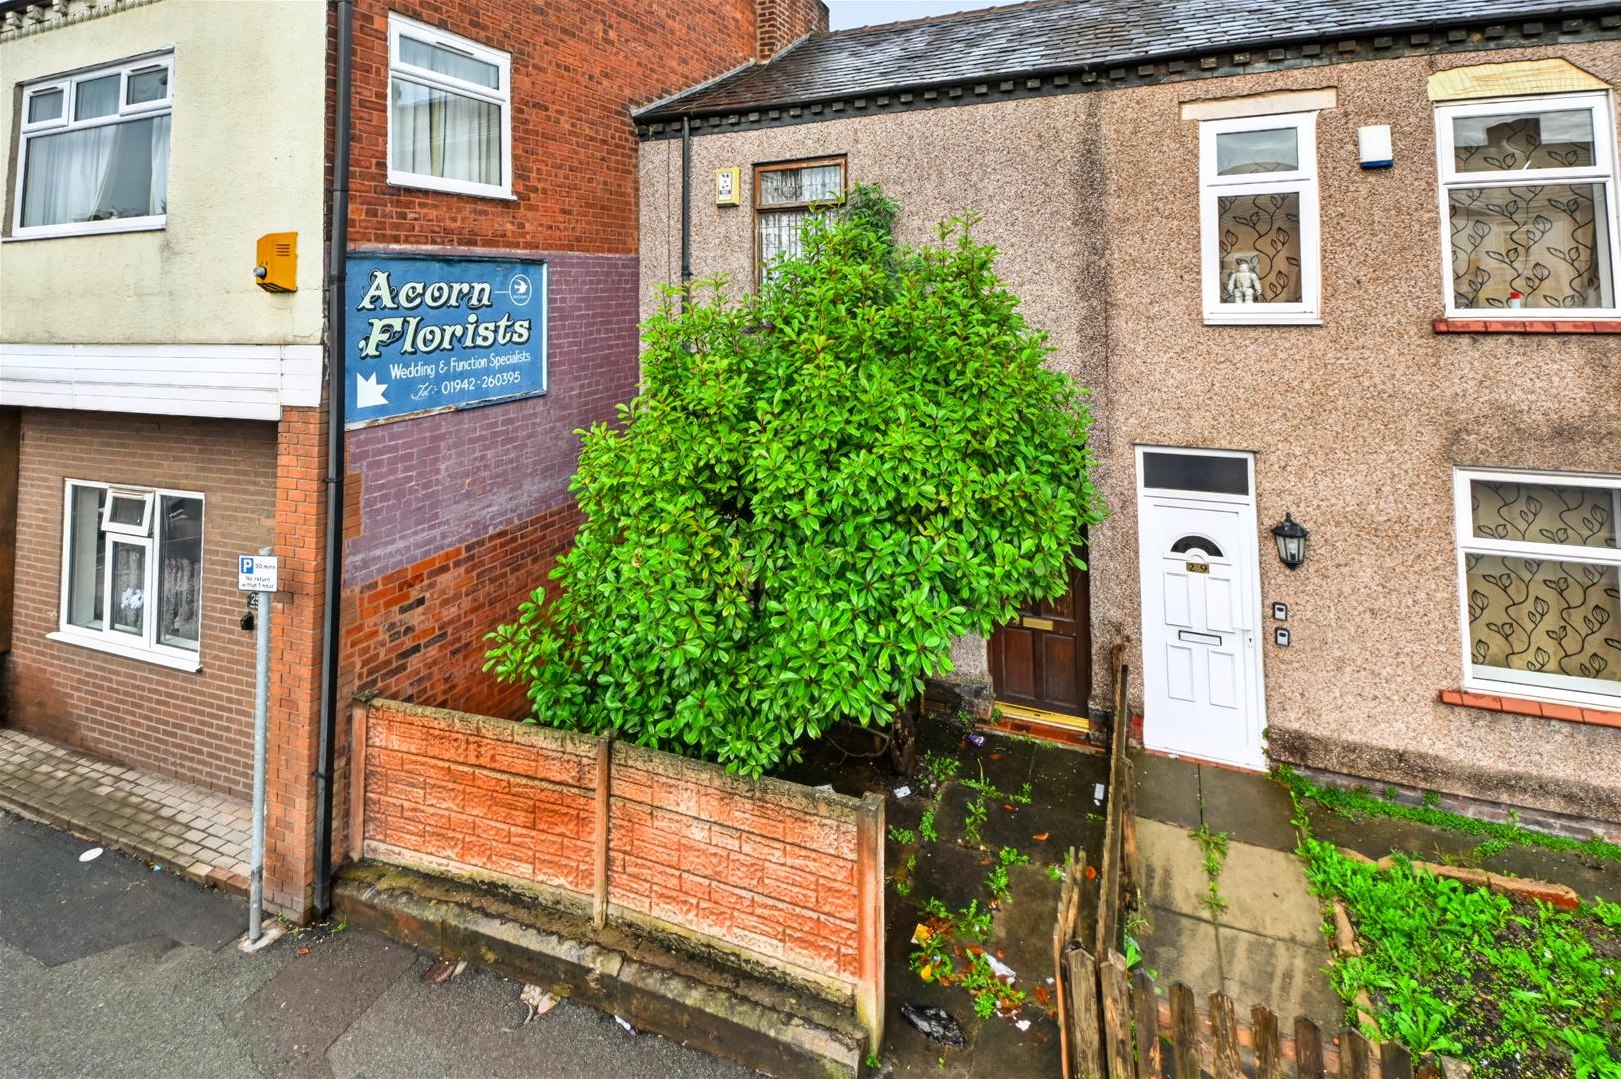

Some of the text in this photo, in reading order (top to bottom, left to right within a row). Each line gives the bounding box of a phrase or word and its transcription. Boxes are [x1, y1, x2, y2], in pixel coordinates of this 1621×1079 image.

[357, 269, 492, 311] Acorn
[358, 312, 532, 360] Florists
[390, 350, 531, 381] Wedding & Function Specialists
[243, 559, 252, 572] P
[1189, 563, 1208, 573] 29
